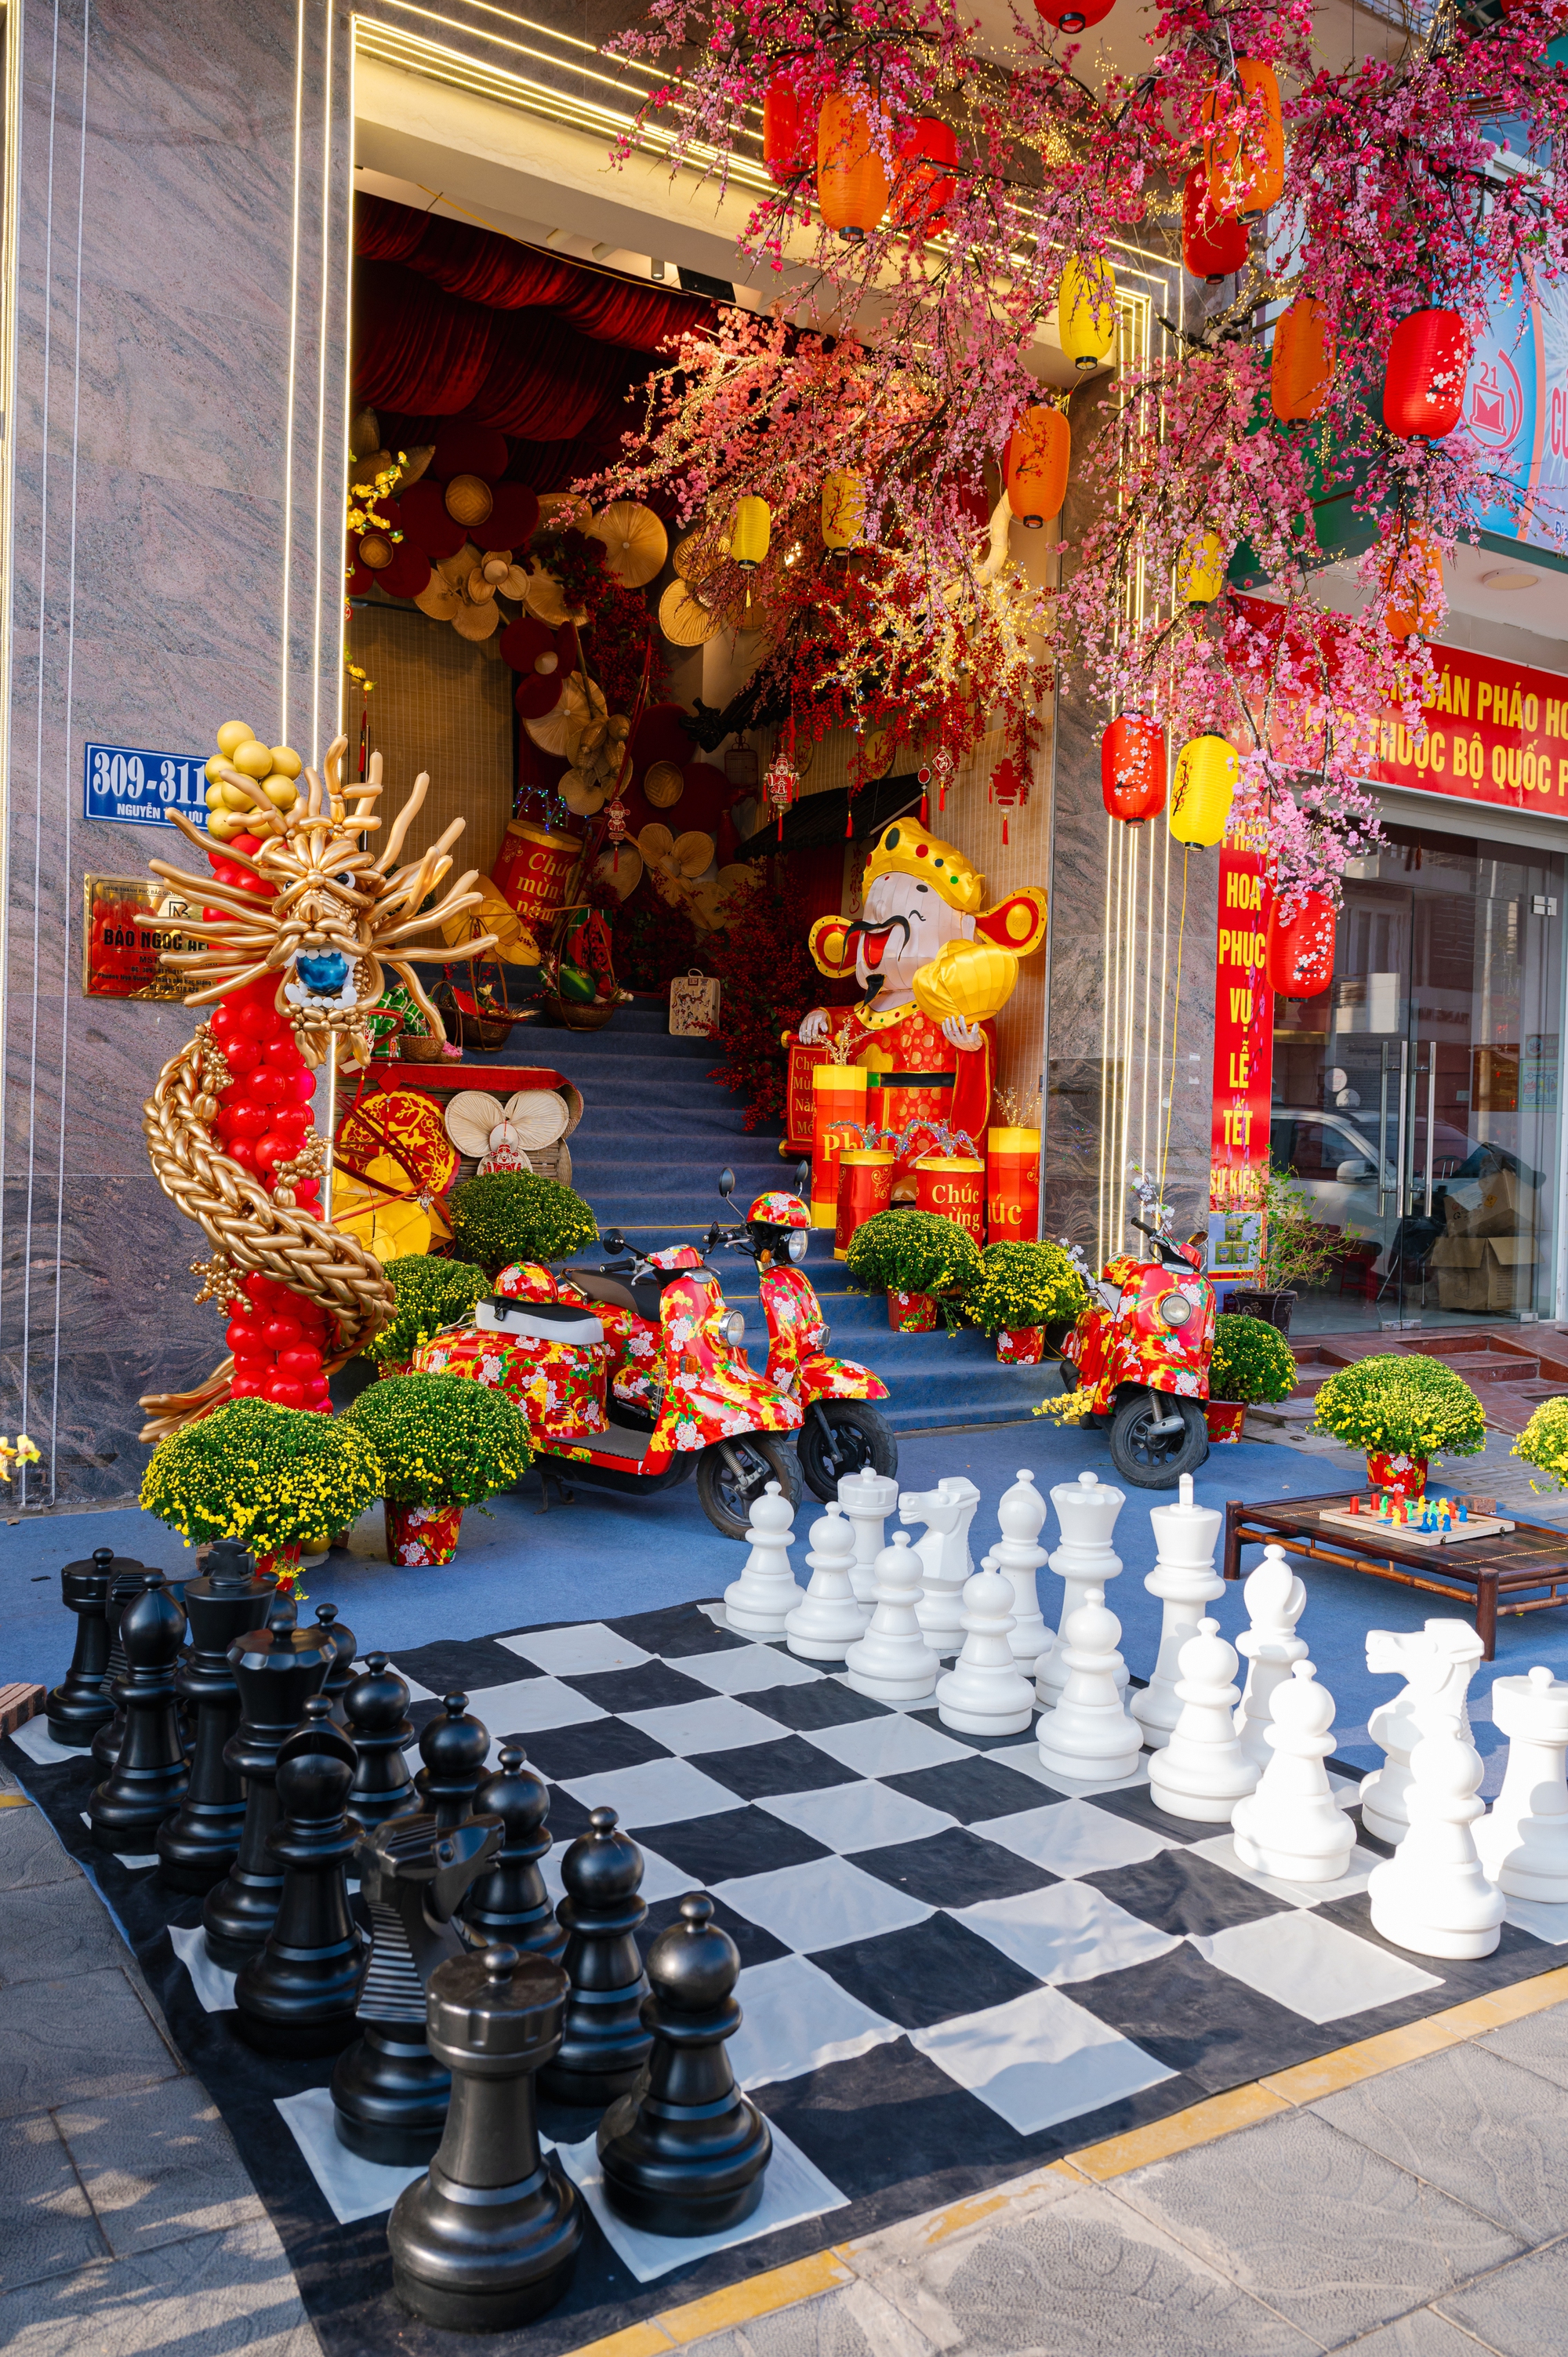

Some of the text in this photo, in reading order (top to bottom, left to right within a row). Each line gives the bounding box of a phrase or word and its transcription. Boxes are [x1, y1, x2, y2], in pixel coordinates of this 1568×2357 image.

[1477, 681, 1538, 732] PHÁO
[1370, 717, 1446, 779] THUỘC
[1453, 732, 1484, 790] BỘ
[1492, 739, 1552, 794] QUỐC
[117, 802, 161, 819] NGUYỄN
[528, 852, 571, 877] Chú
[1226, 871, 1261, 911] HOA
[103, 924, 135, 947] BẢO
[141, 932, 182, 952] NGỌC
[1218, 928, 1266, 975] PHỤC
[1229, 988, 1252, 1032] VỤ
[1229, 1040, 1250, 1088] LỄ
[1223, 1099, 1253, 1146] TẾT
[931, 1182, 979, 1204] Chúc
[1210, 1164, 1259, 1200] SỰ KIỆN
[939, 1206, 980, 1233] ừng
